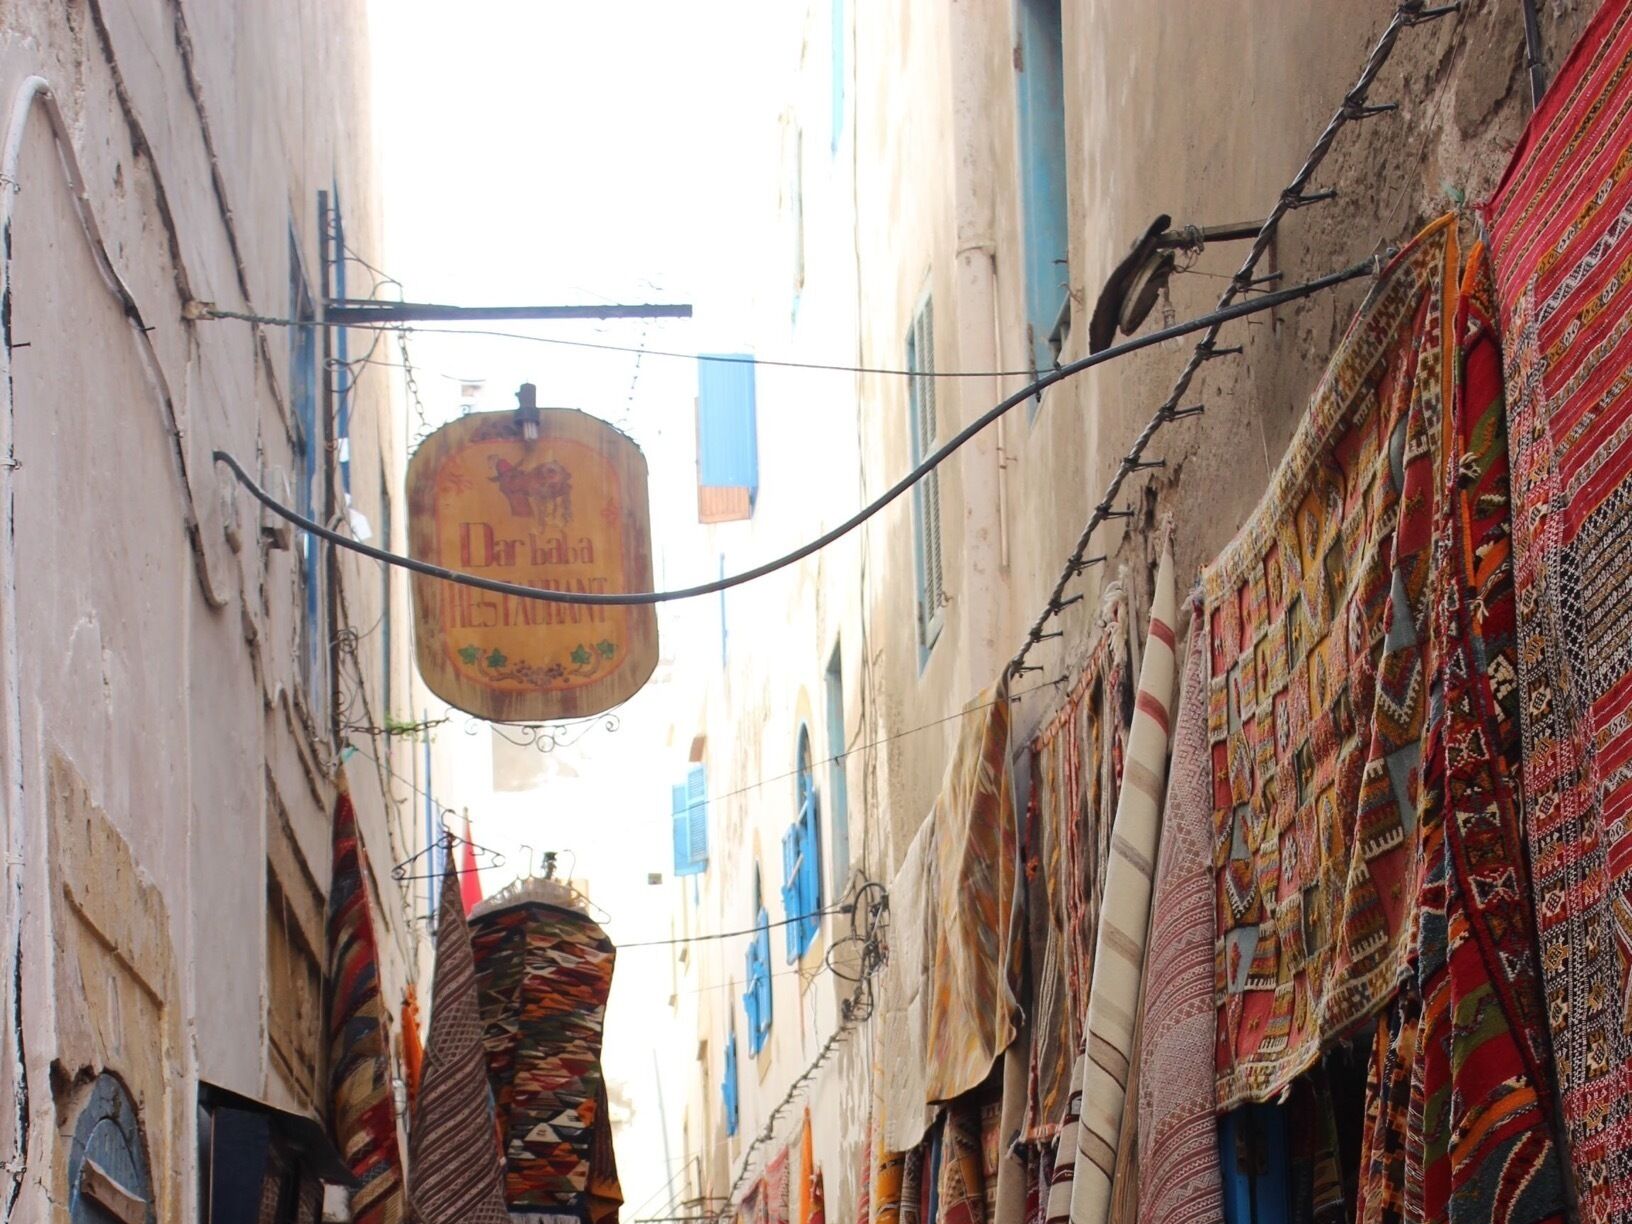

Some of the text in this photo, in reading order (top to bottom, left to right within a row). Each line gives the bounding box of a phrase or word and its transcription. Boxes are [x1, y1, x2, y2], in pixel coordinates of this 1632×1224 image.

[459, 521, 594, 567] Dar baba
[449, 577, 608, 628] RESTAURANT
